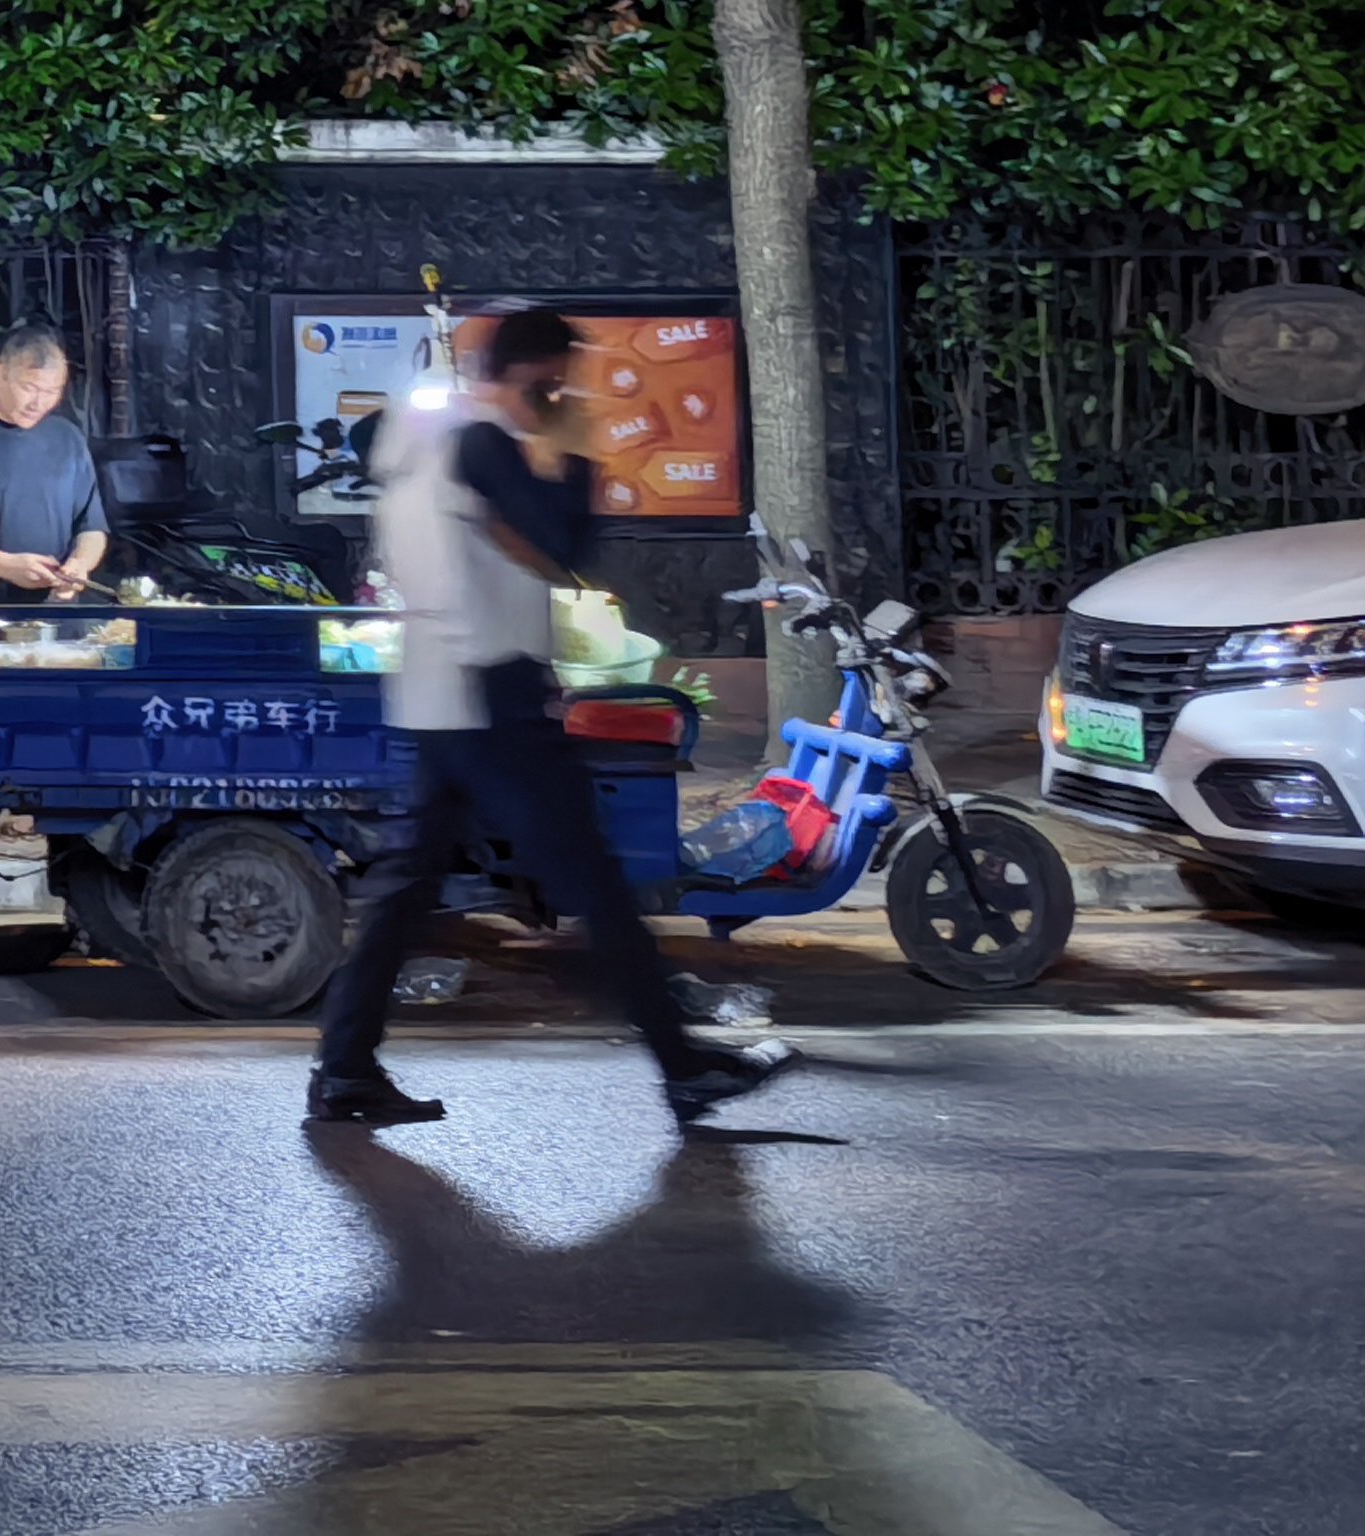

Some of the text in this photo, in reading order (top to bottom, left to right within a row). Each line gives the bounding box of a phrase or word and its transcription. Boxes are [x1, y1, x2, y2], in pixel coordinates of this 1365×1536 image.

[656, 320, 709, 346] SALE
[664, 463, 718, 481] SALE
[140, 695, 342, 735] 众兄弟车行
